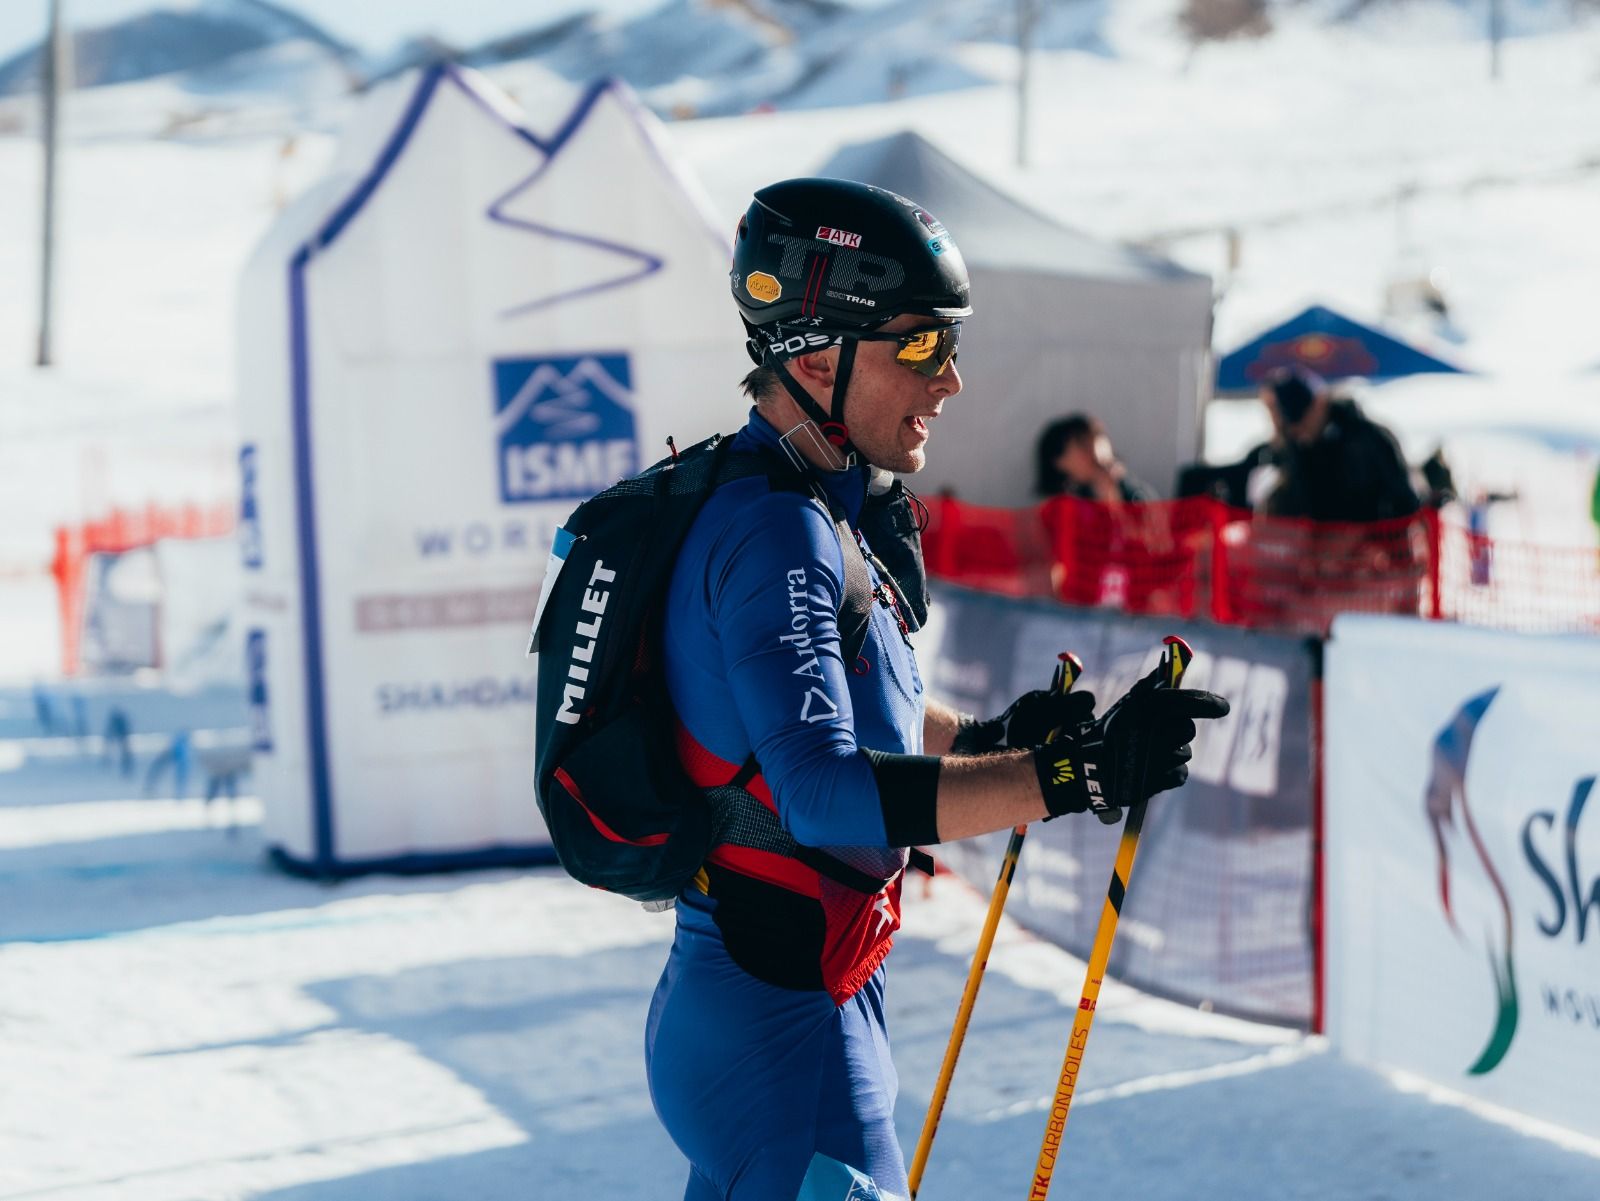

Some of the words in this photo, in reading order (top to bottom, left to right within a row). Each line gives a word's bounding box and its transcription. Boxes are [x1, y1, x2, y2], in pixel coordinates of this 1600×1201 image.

[830, 229, 862, 247] ATK
[416, 521, 553, 558] WORL
[555, 559, 617, 725] MILLET
[779, 567, 826, 683] Andorra
[375, 677, 538, 713] SHAHDA
[1521, 774, 1600, 944] Sh
[1061, 1026, 1089, 1088] POLES
[1039, 1091, 1073, 1171] CARBON
[1030, 1172, 1051, 1201] TK
